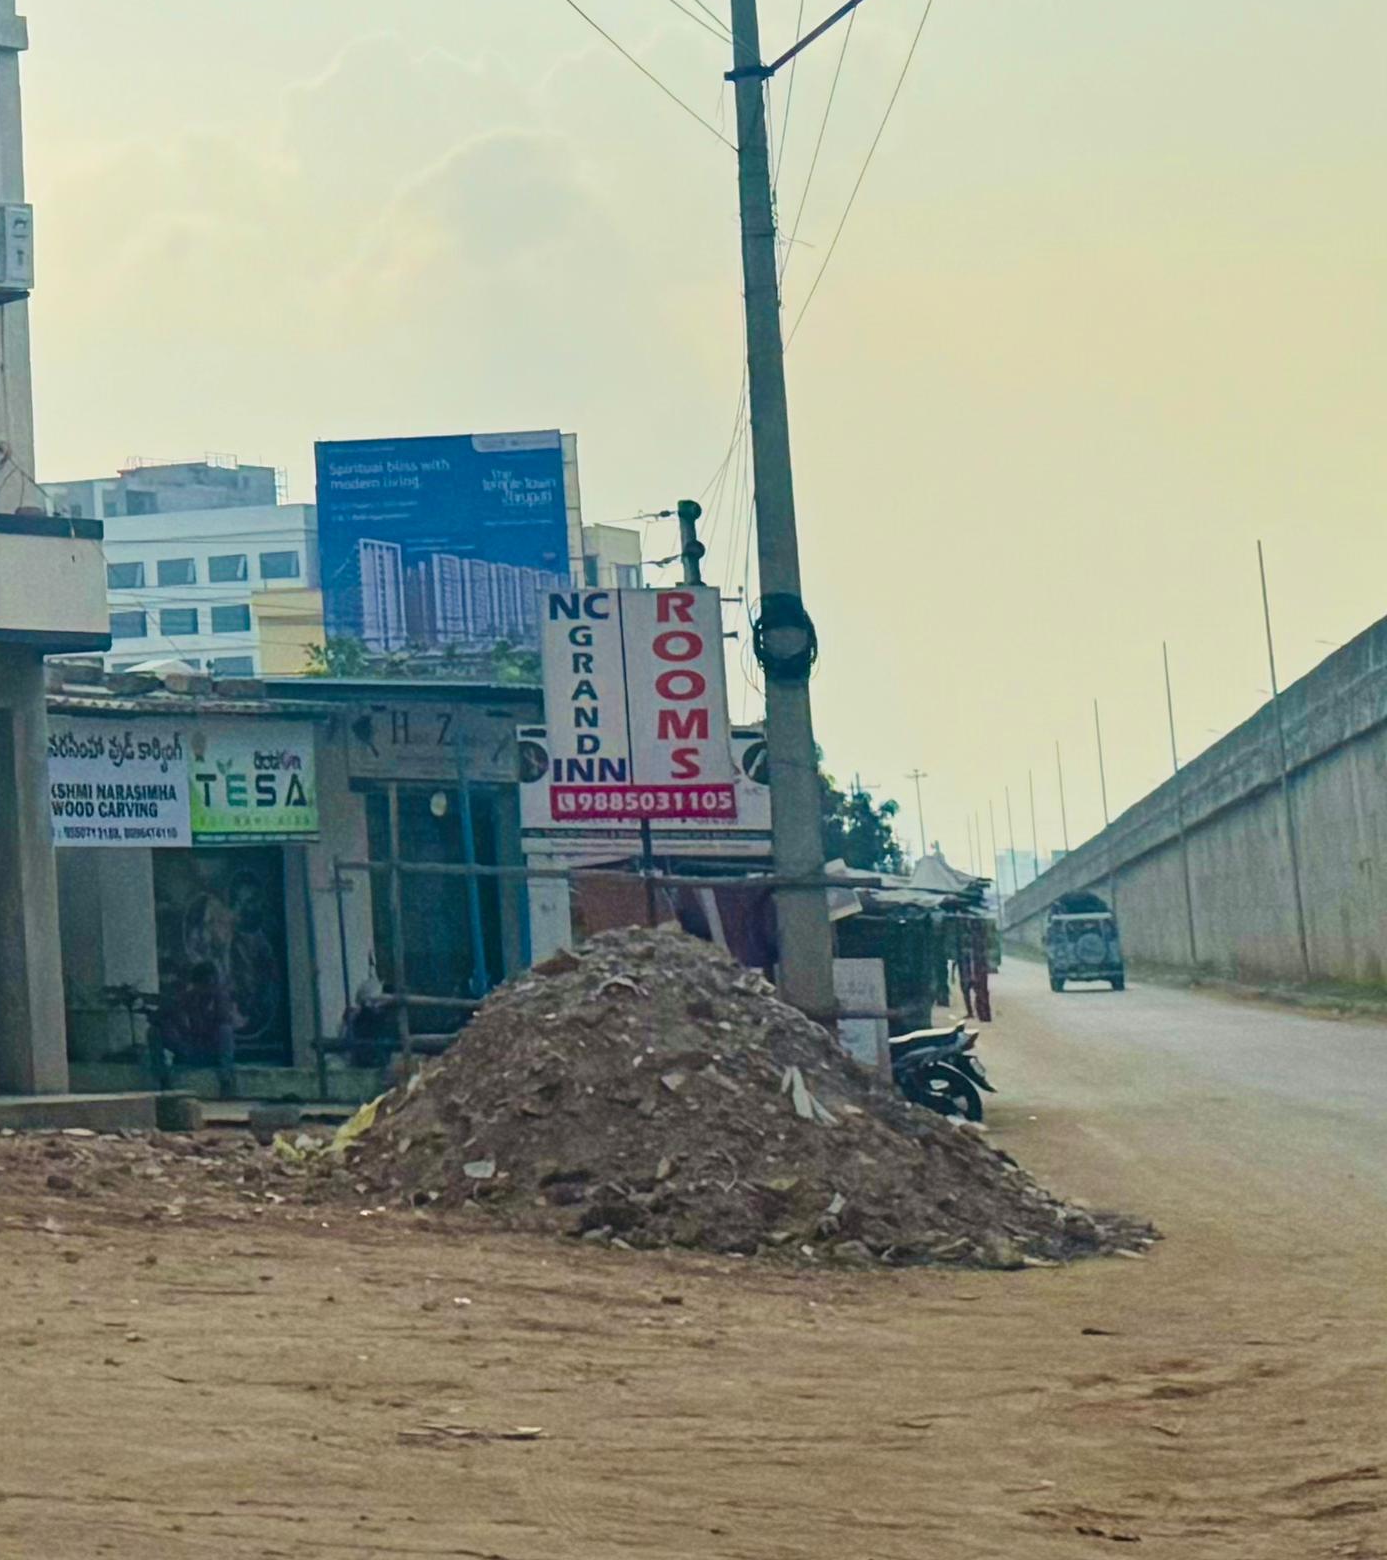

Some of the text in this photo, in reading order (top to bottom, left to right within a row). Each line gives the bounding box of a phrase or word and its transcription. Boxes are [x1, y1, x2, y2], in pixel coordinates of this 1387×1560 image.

[549, 592, 610, 620] NC
[568, 624, 601, 756] GRAND
[651, 591, 709, 781] ROOMS
[553, 758, 626, 783] INN
[96, 784, 177, 801] NARASIMHA
[195, 773, 308, 808] TESA
[578, 791, 733, 812] 9885031105
[51, 800, 159, 819] WOOD CARVING
